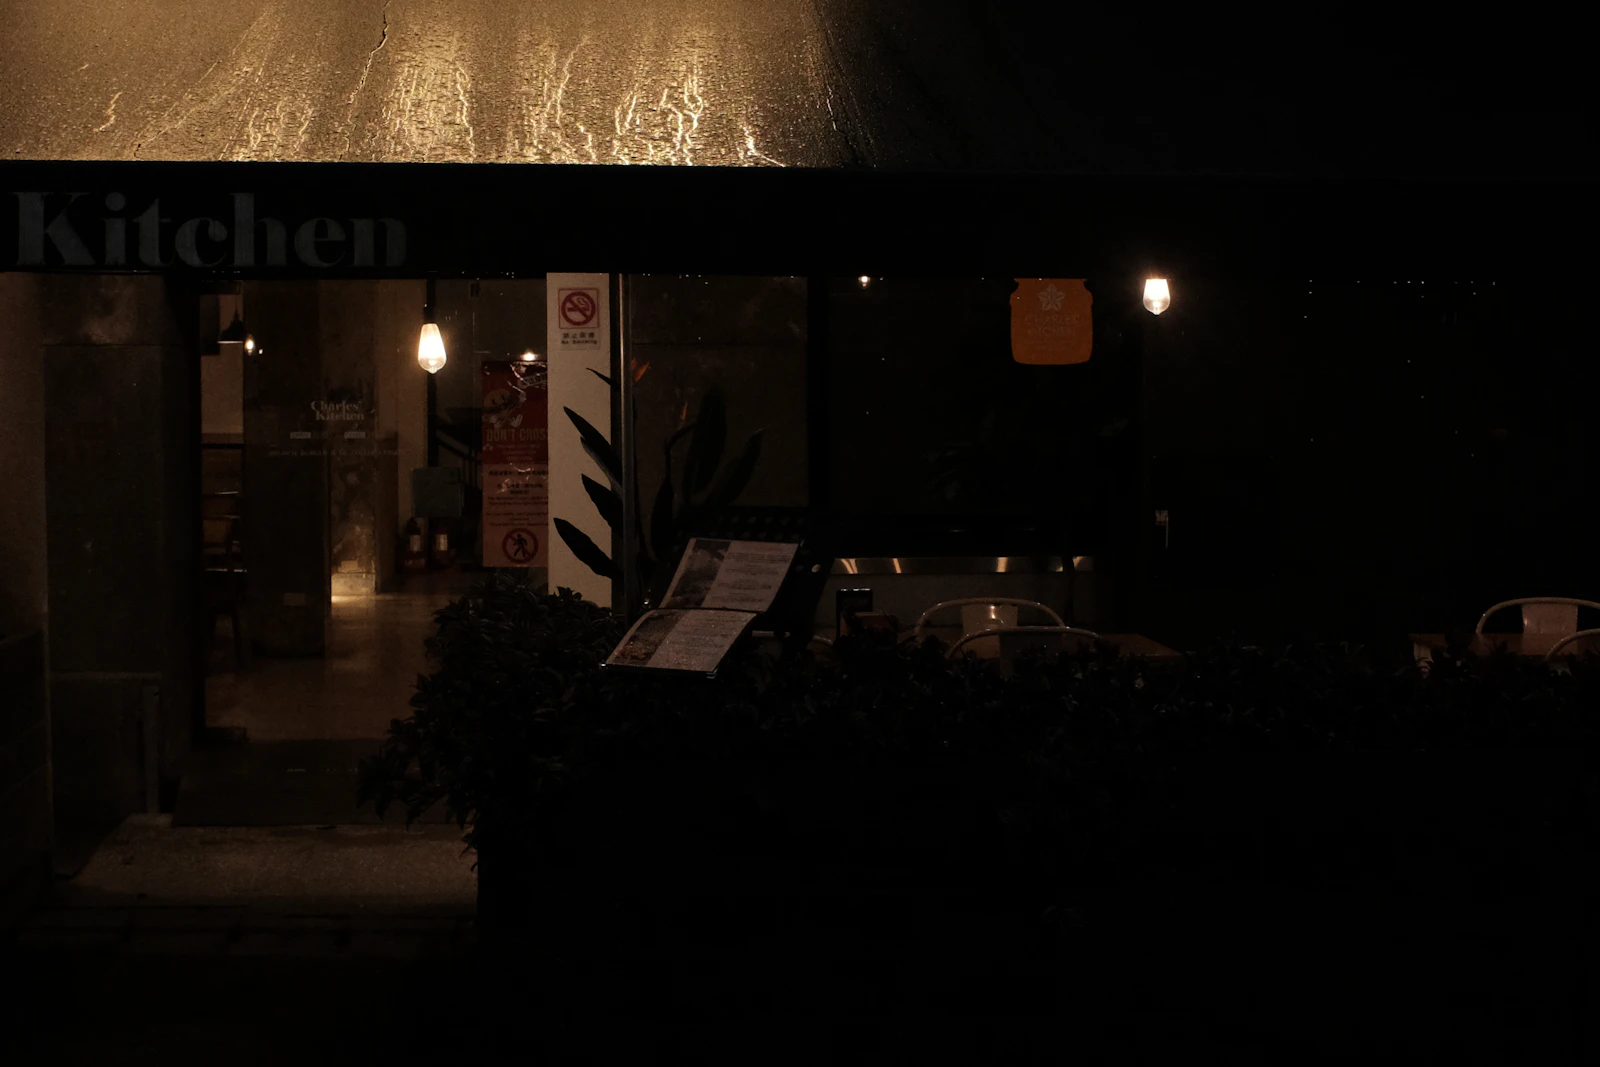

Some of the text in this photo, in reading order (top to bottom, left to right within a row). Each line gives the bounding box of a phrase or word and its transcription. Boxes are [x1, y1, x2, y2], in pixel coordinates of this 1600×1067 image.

[9, 191, 408, 268] Kitchen
[315, 410, 365, 421] Kitchen
[486, 428, 548, 442] DON'T CROS
